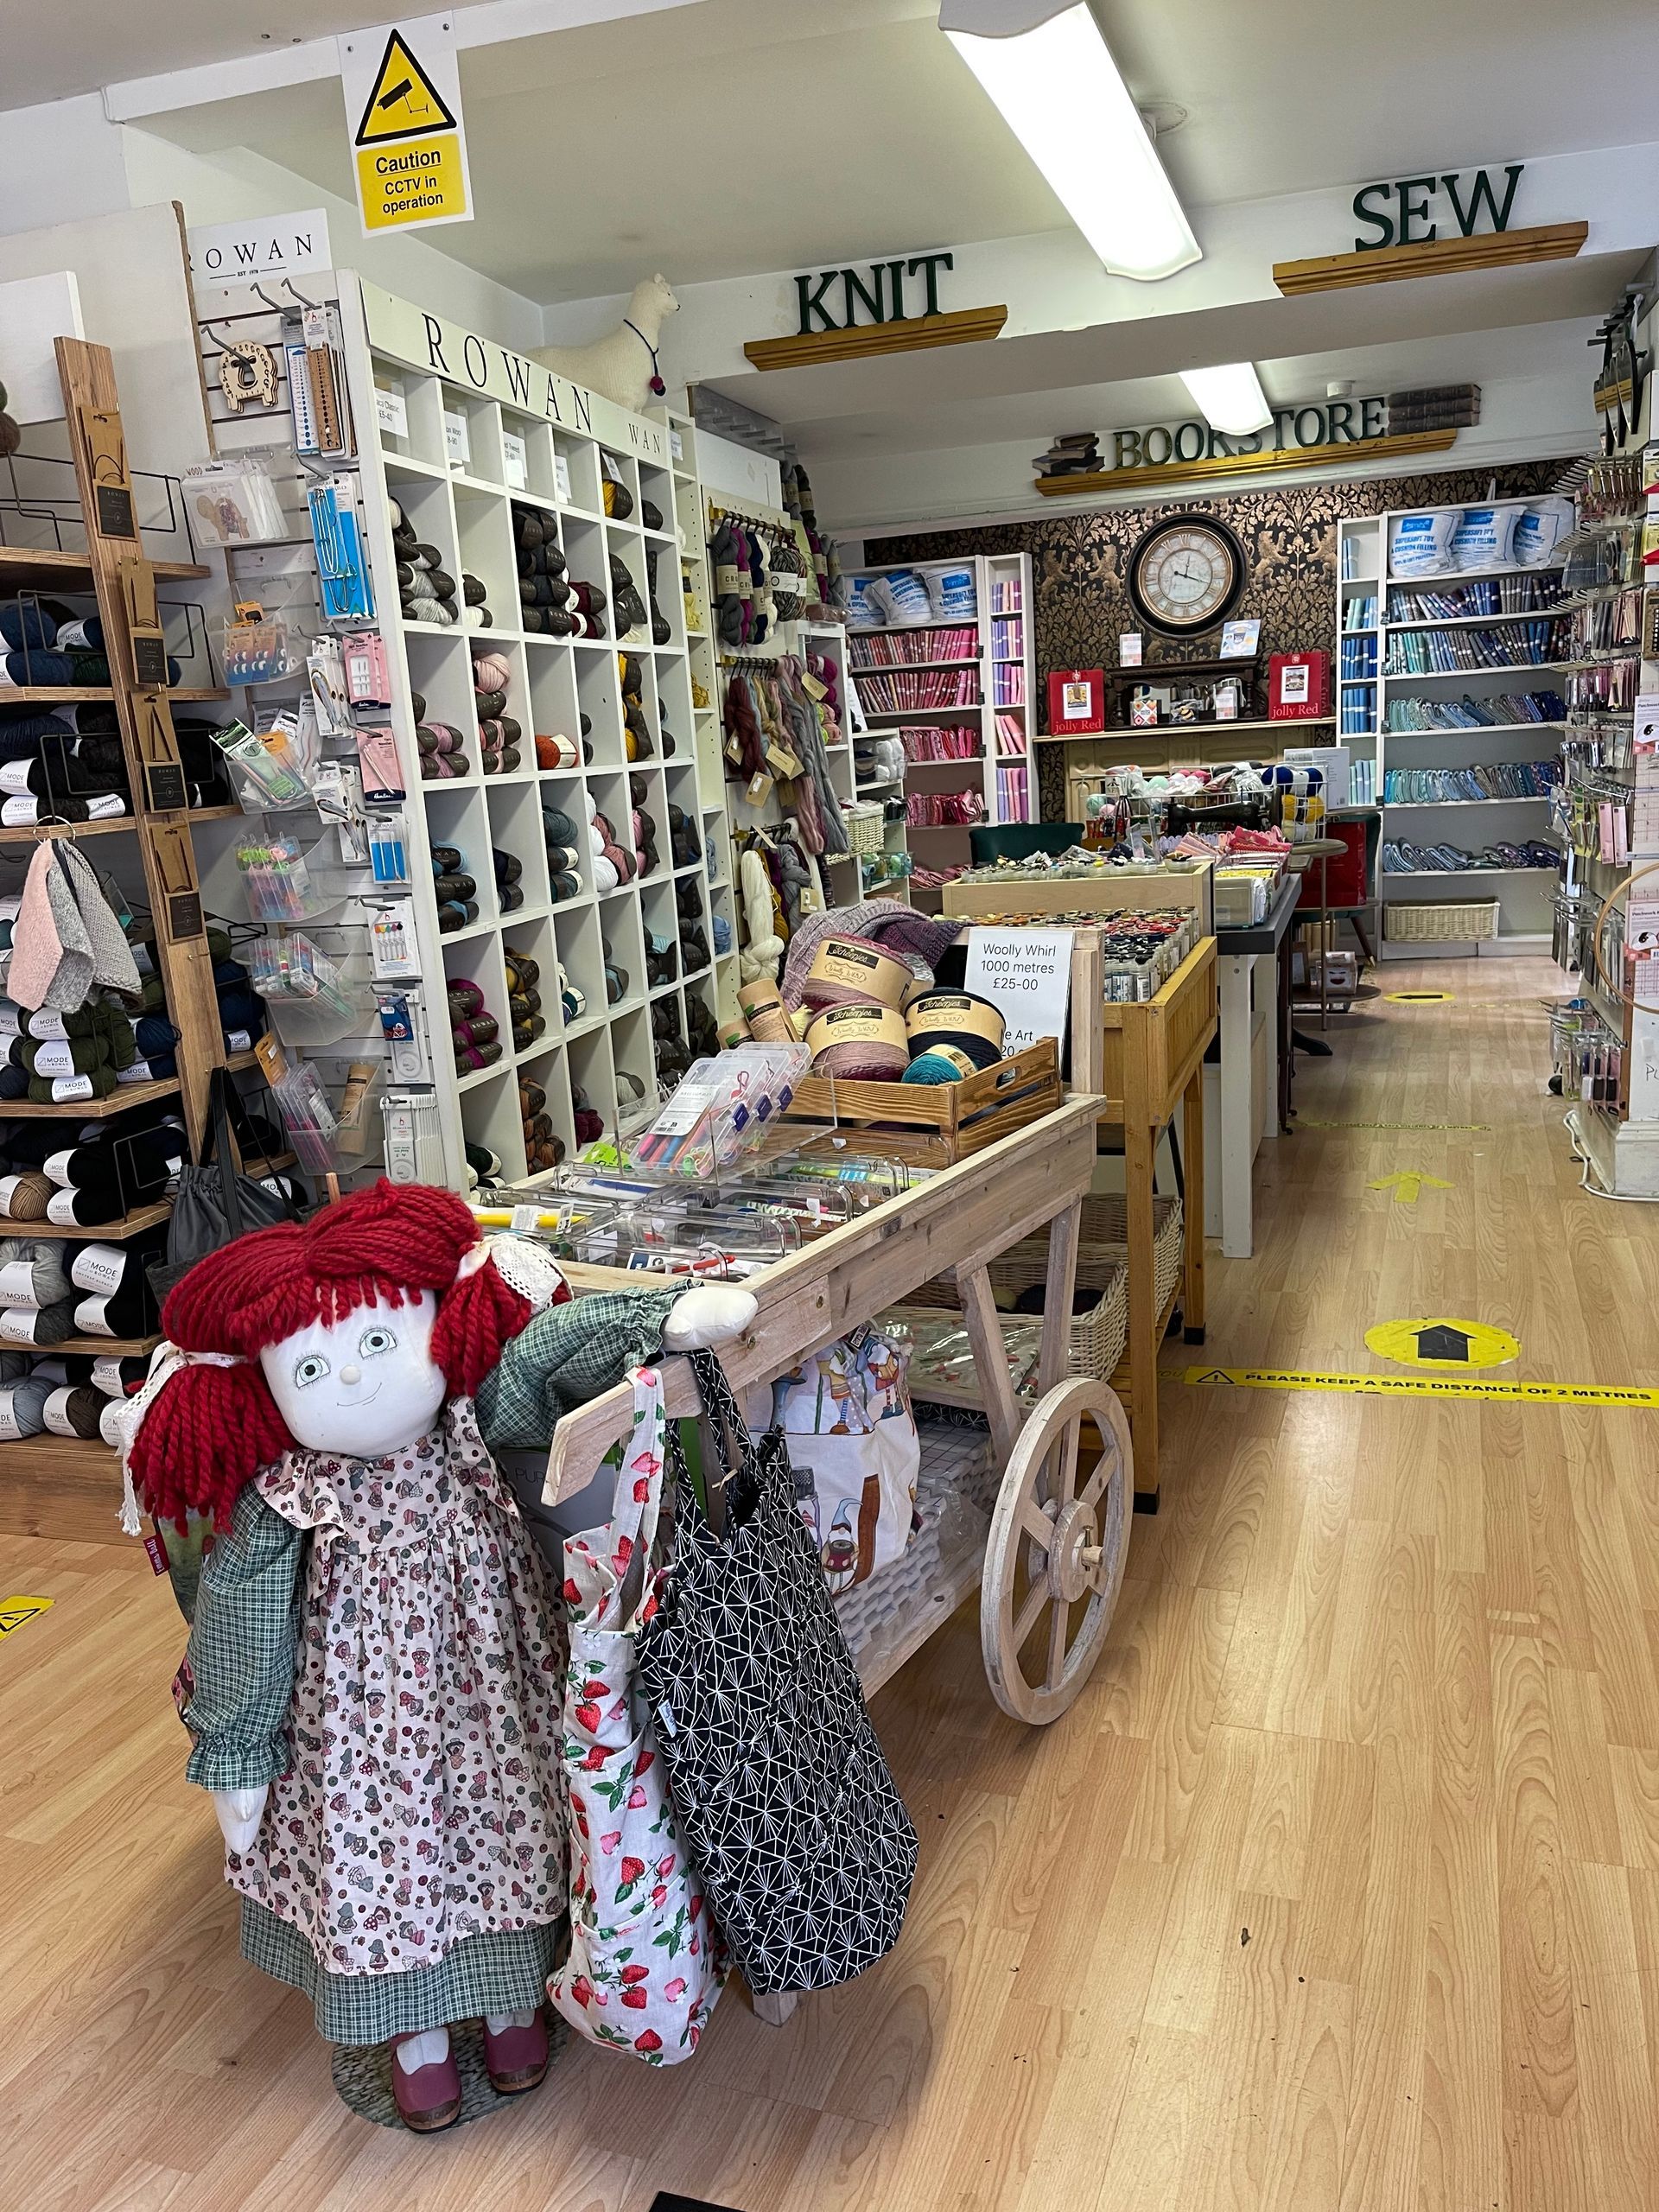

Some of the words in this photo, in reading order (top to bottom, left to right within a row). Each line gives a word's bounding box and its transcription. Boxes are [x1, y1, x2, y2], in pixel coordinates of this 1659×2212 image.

[376, 150, 442, 174] Caution
[385, 176, 421, 195] CCTV
[424, 175, 437, 188] in
[383, 194, 443, 216] operation
[1353, 164, 1524, 251] SEW
[793, 252, 953, 335] KNIT
[421, 312, 593, 434] ROWAN
[628, 423, 660, 454] WAN
[1272, 706, 1297, 719] jolly
[1298, 703, 1319, 715] Red
[1055, 721, 1080, 734] jolly
[1081, 718, 1102, 731] Red
[98, 800, 119, 809] MODE
[827, 945, 868, 963] Scheepjes
[983, 944, 1022, 957] Woolly
[1026, 944, 1056, 957] Whirl
[982, 960, 1010, 972] 1000
[1013, 963, 1055, 974] metres
[993, 977, 1039, 990] £25-00
[921, 1000, 962, 1010] Scheepjes
[827, 1009, 873, 1021] Scheepjes
[1014, 1030, 1033, 1041] Art
[91, 1262, 118, 1277] MODE
[6, 1293, 31, 1301] MODE
[10, 1326, 30, 1338] MODE
[86, 1321, 106, 1330] MODE
[1245, 1374, 1311, 1382] PLEASE
[1431, 1383, 1522, 1394] DISTANCE
[1573, 1390, 1652, 1401] METRES
[147, 1539, 158, 1555] Ball
